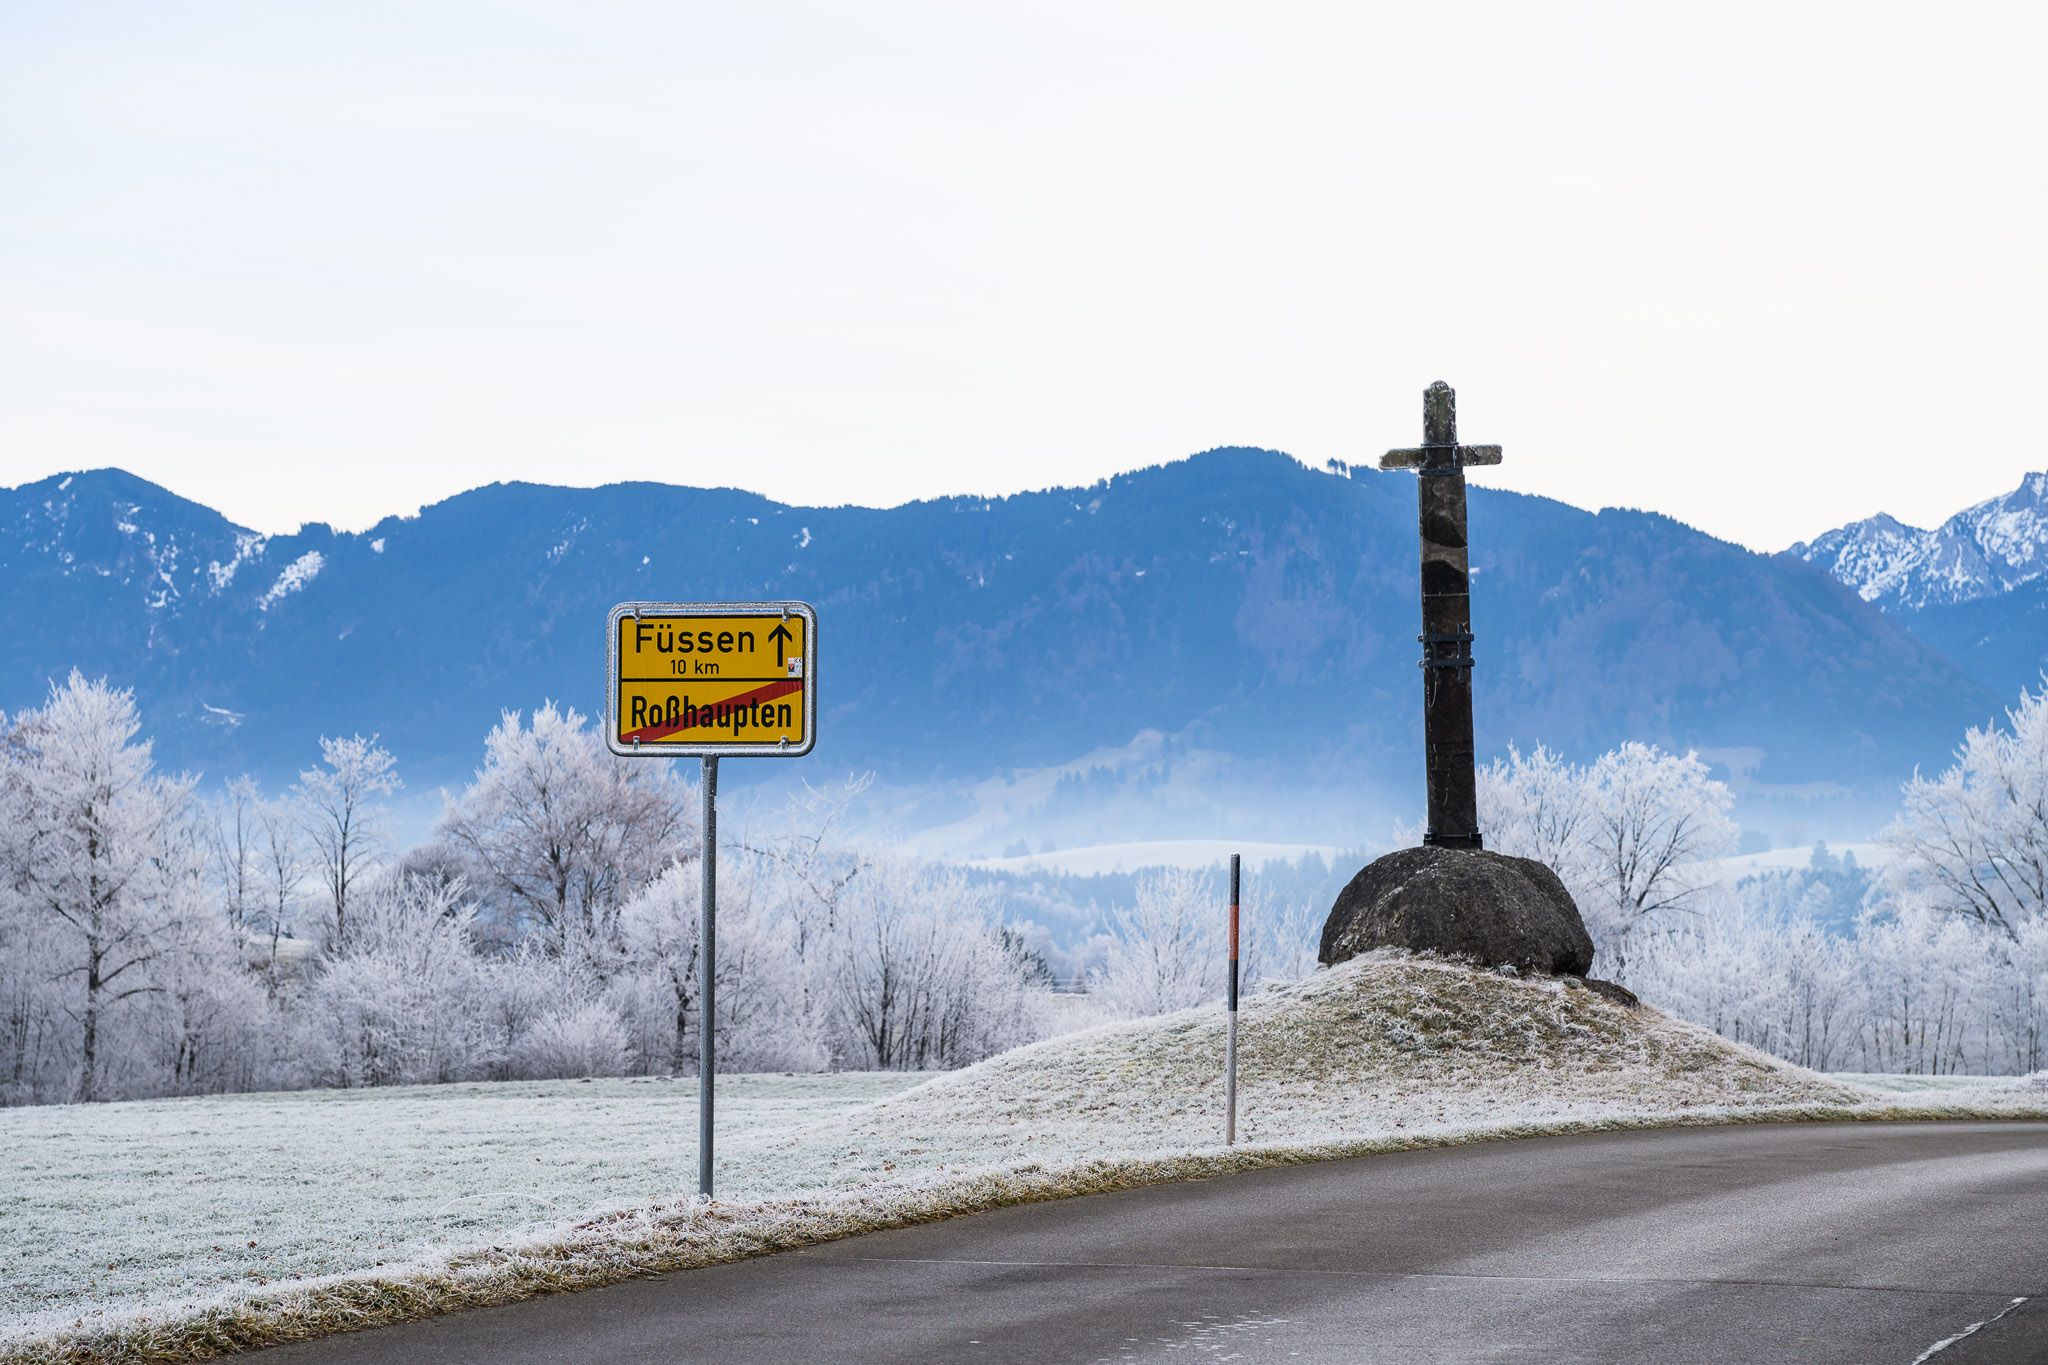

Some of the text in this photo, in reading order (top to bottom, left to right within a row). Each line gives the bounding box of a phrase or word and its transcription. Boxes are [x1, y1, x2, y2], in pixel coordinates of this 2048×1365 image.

[636, 624, 755, 654] Füssen
[671, 659, 720, 675] 10 km
[631, 695, 792, 737] Roßhaupten
